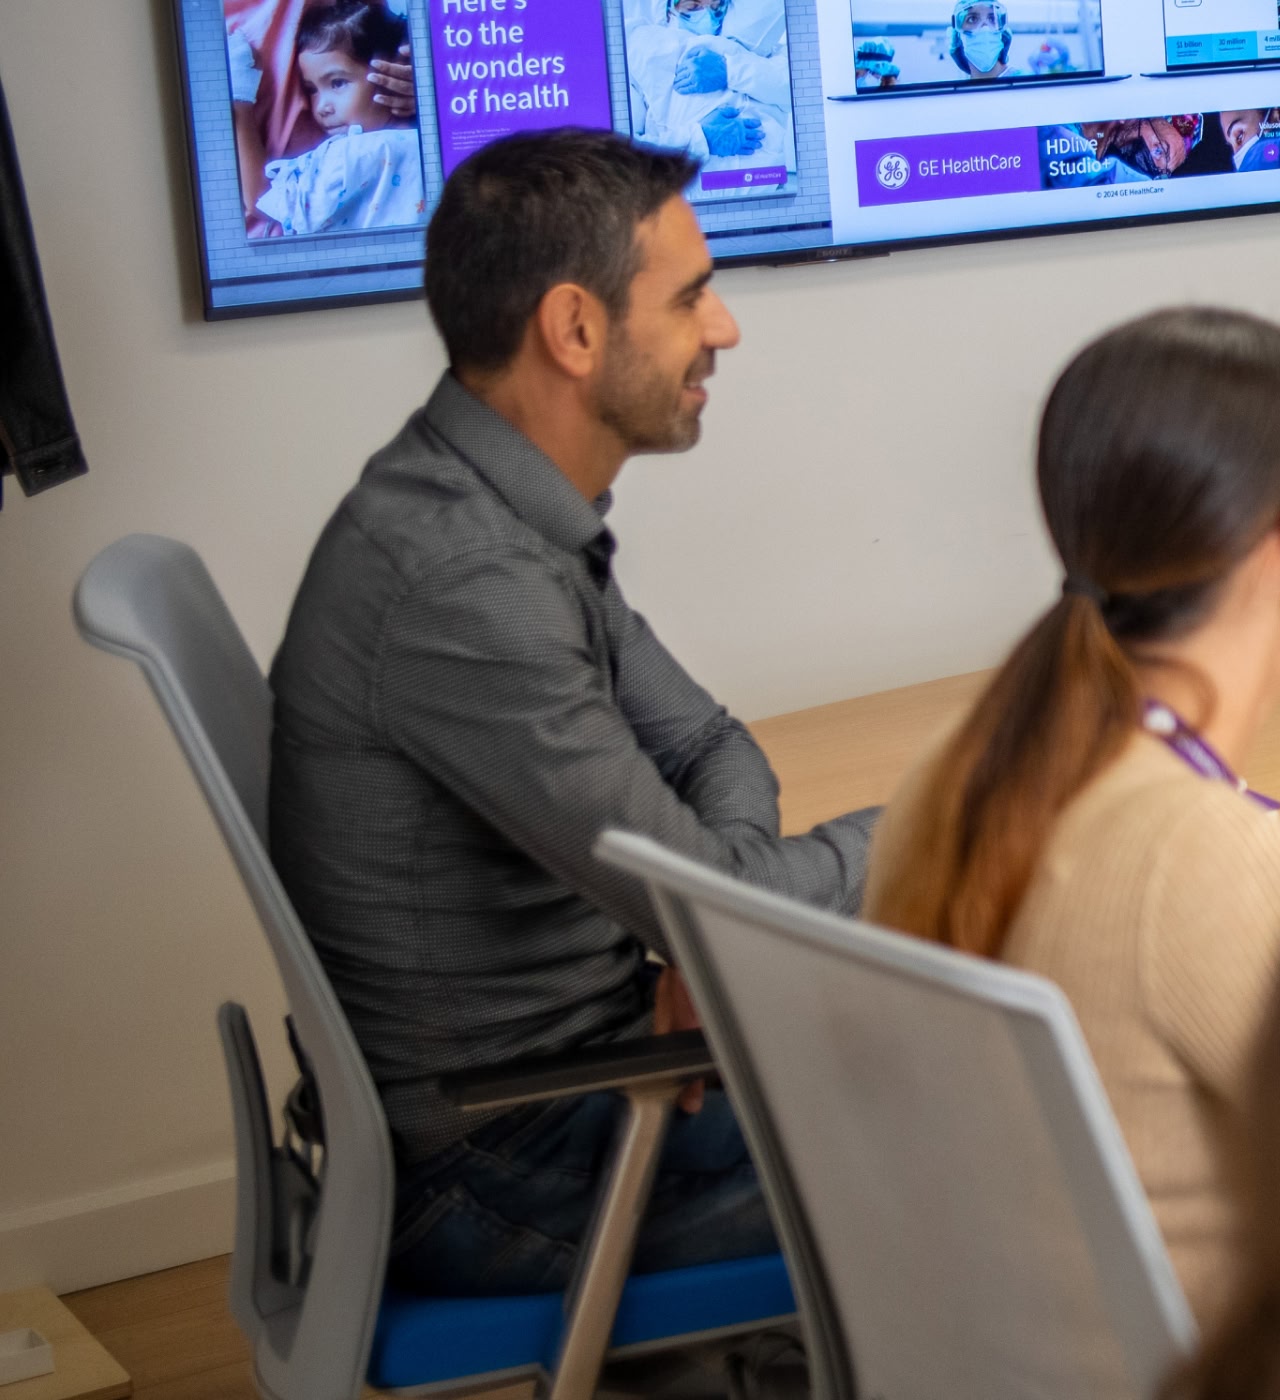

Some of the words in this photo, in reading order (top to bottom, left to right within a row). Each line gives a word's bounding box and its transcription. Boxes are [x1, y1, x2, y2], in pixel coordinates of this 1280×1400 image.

[444, 25, 473, 47] to
[478, 20, 524, 45] the
[447, 52, 566, 81] wonders
[451, 89, 478, 114] of
[484, 83, 569, 112] health
[919, 160, 939, 177] GE
[942, 154, 1022, 175] HealthCare
[1049, 156, 1111, 177] Studio+
[1103, 190, 1119, 199] 2024
[1120, 189, 1128, 197] GE
[1129, 187, 1164, 196] HealthCare
